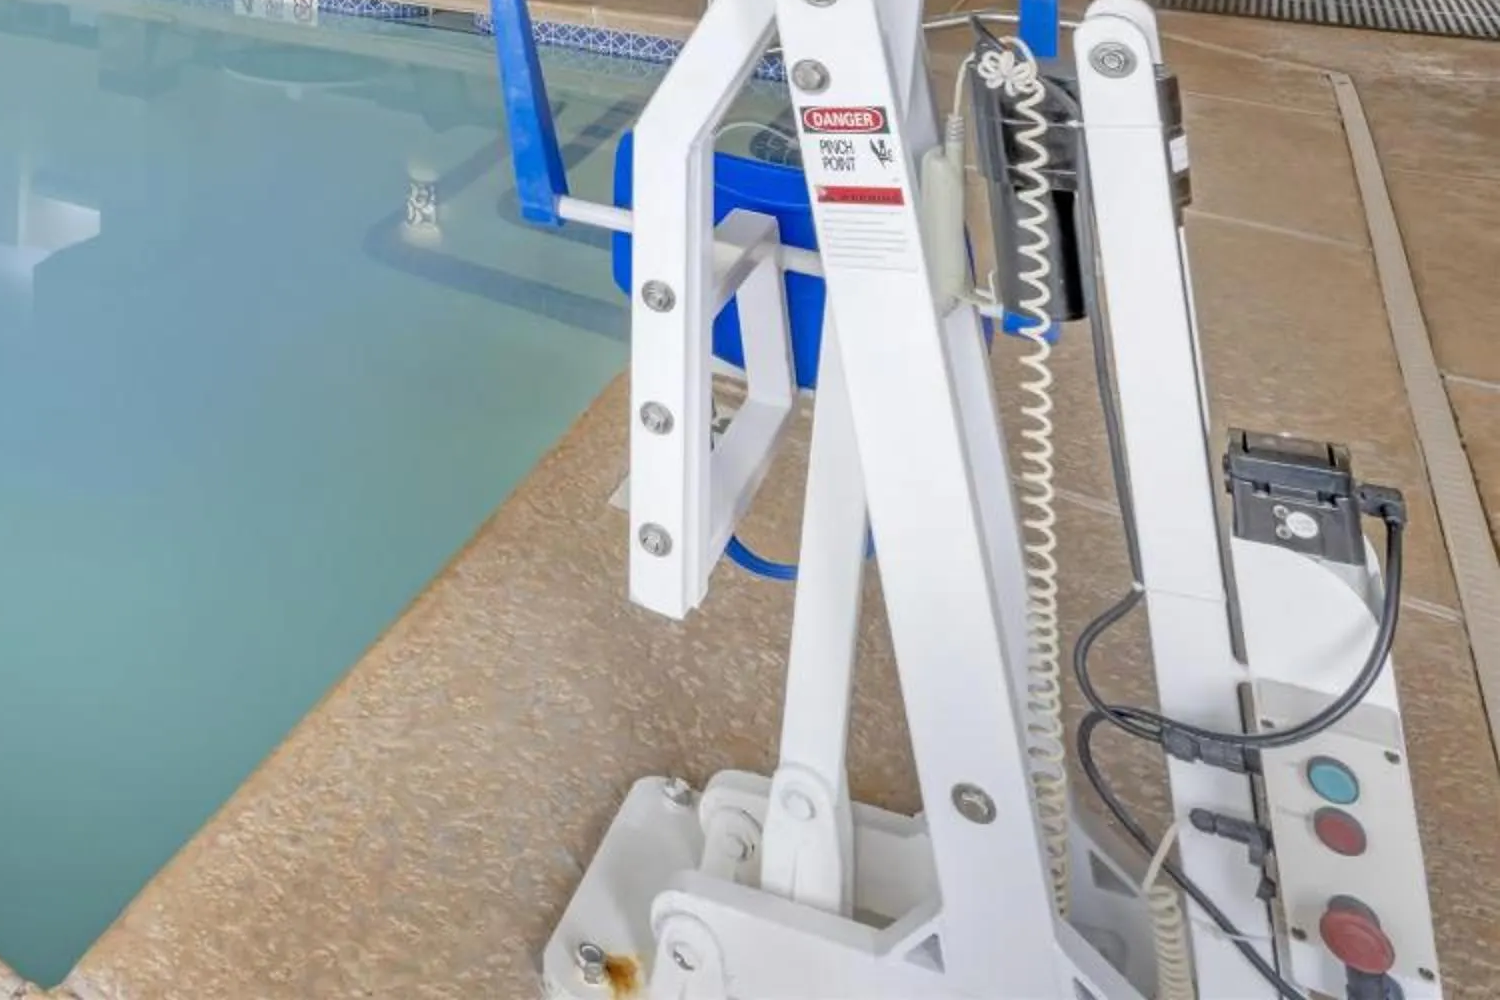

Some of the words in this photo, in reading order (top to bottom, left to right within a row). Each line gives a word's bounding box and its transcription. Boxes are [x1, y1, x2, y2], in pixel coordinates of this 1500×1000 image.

[811, 111, 875, 128] DANGER
[819, 139, 855, 155] PINCH
[821, 156, 856, 172] POINT
